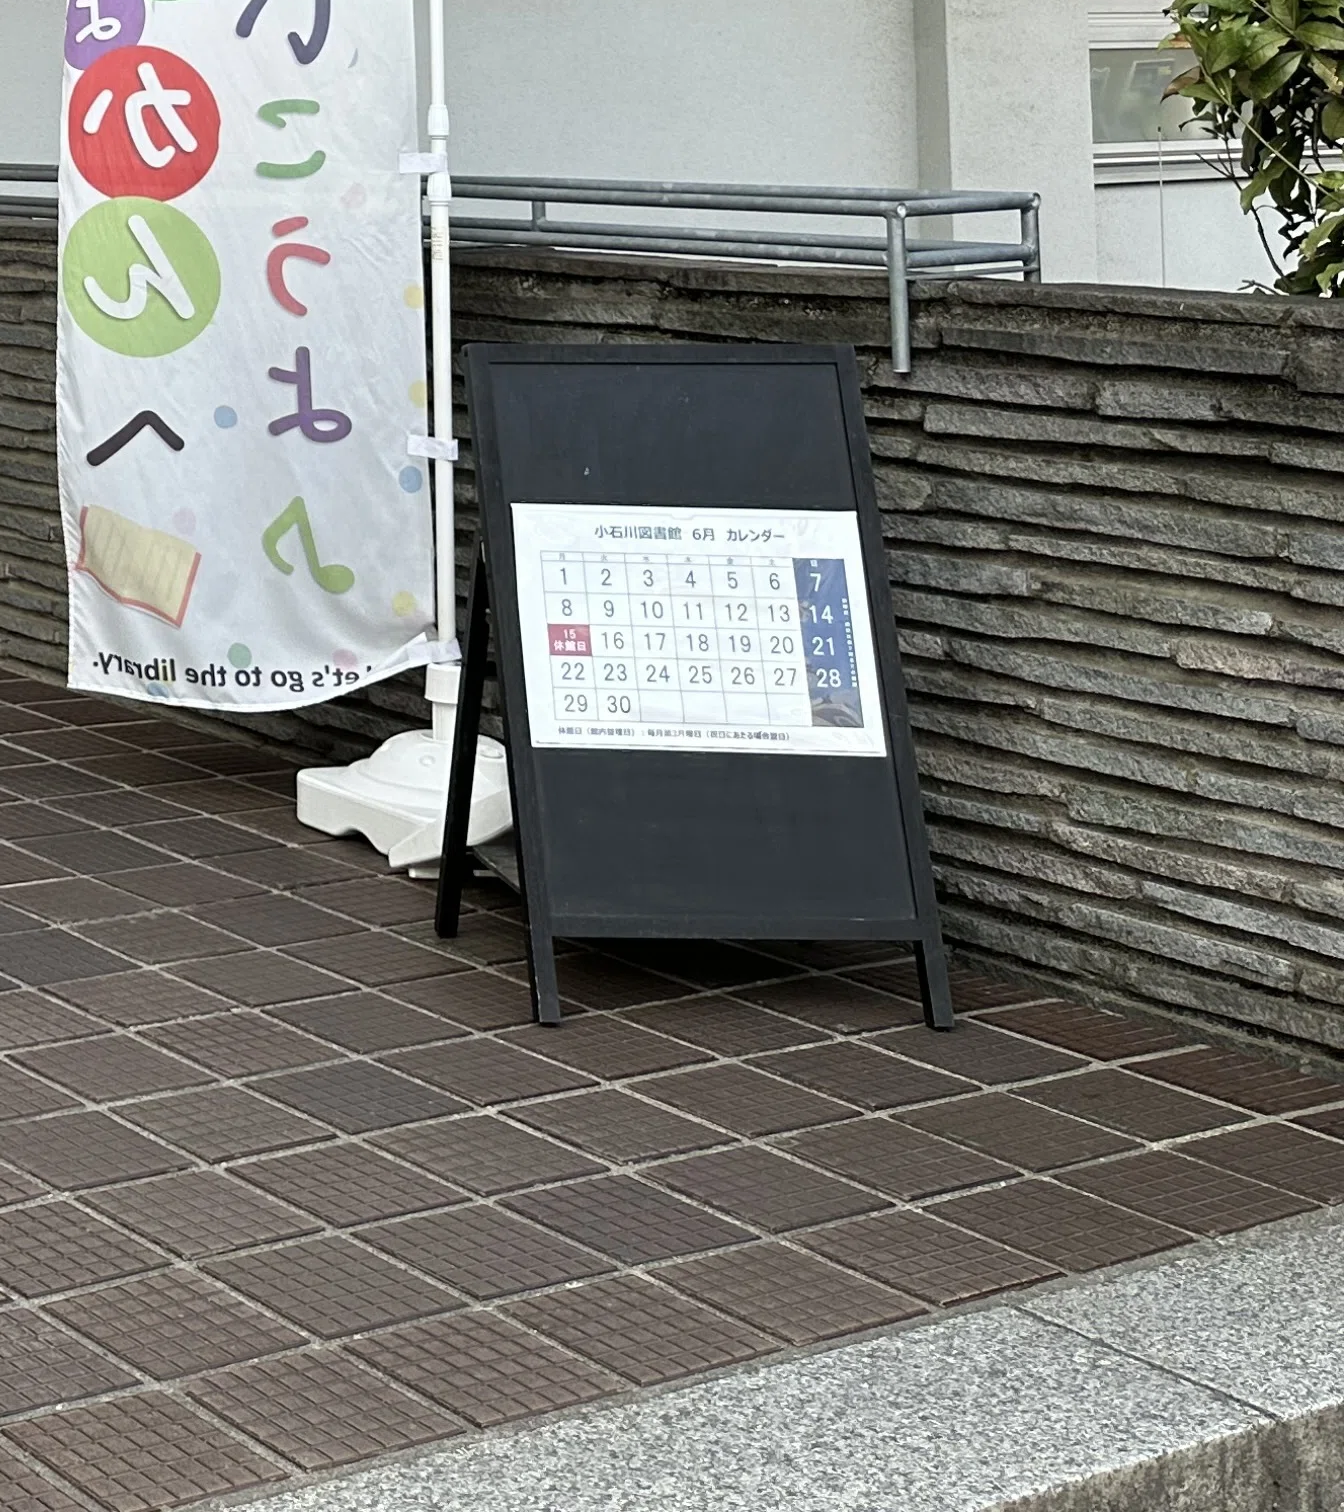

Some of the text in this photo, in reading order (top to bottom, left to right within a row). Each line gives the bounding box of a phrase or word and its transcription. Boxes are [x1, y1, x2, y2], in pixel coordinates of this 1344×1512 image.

[594, 525, 785, 543] 小石川図書館 6月 カレンダー
[560, 568, 821, 591] 1 2 3 4 5 6 7
[562, 599, 833, 624] 8 9 10 11 12 13 14
[554, 640, 587, 652] 休館日
[563, 630, 834, 656] 15 16 17 18 19 20 21
[561, 662, 841, 687] 22 23 24 25 26 27 28
[564, 695, 631, 713] 29 30
